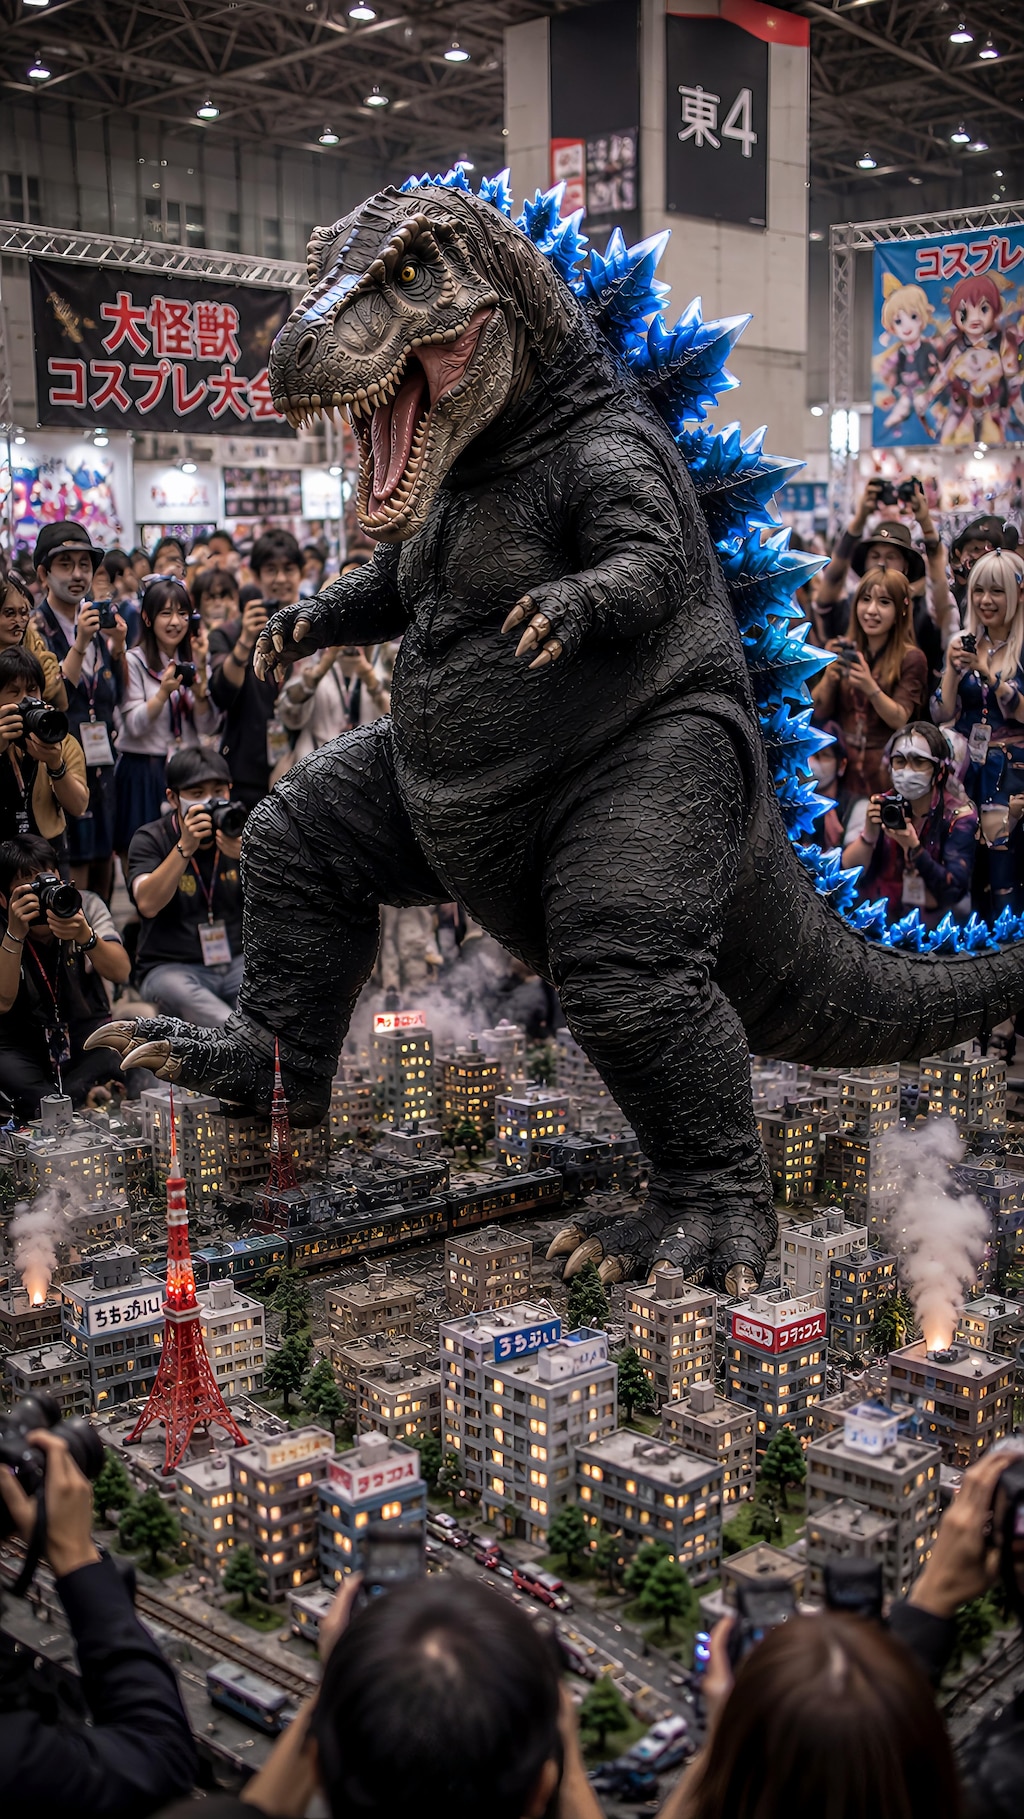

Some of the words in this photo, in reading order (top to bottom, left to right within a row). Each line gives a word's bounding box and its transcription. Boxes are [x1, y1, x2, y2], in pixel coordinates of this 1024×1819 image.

[678, 85, 758, 158] 東4
[916, 235, 1024, 282] コスプレ
[101, 291, 242, 364] 大怪獣
[48, 356, 287, 423] コスプレ大会
